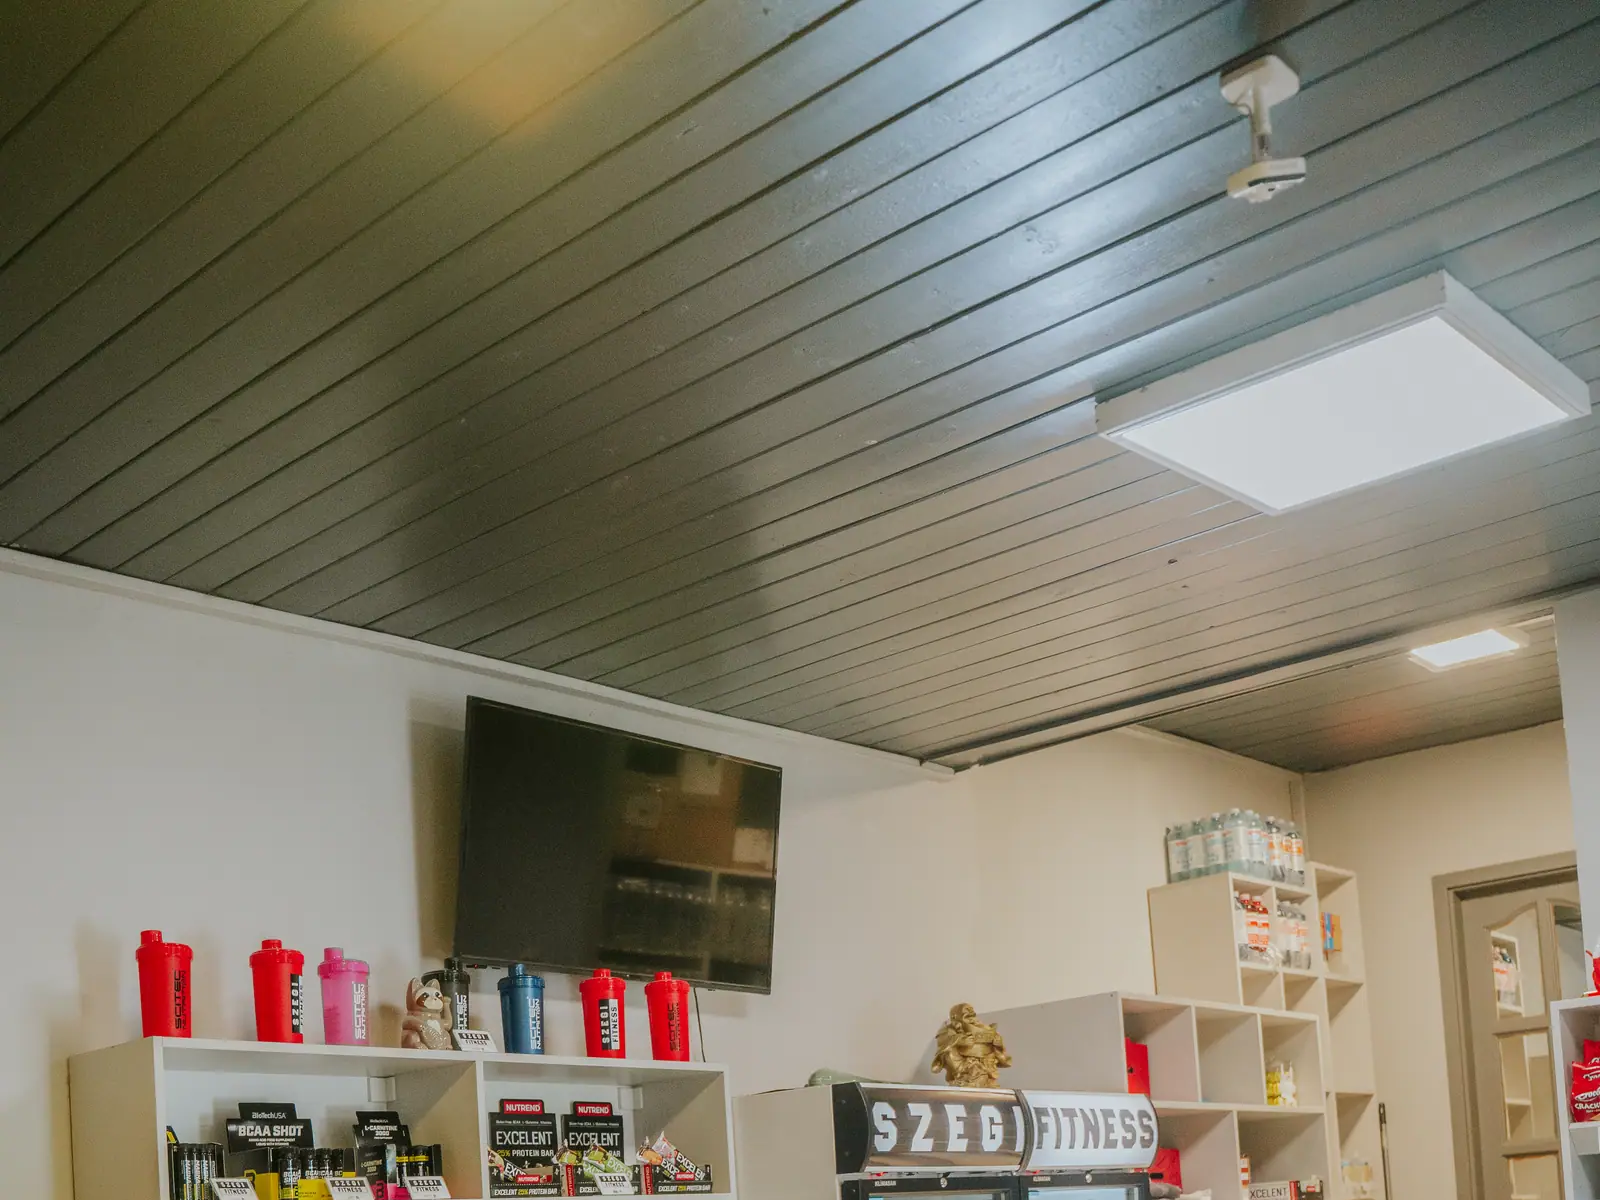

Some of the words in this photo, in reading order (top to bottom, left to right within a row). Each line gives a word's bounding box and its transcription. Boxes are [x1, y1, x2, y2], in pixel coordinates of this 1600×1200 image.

[173, 970, 182, 1029] SCITEC
[291, 982, 299, 1026] SZEGI
[353, 983, 362, 1040] SCITEC
[528, 998, 536, 1050] SCITEC
[600, 1005, 610, 1044] SZEGI
[611, 1006, 619, 1043] FITNESS
[667, 1002, 676, 1051] SCITEC
[505, 1103, 541, 1112] NUTREND
[578, 1106, 609, 1114] NUTREND
[238, 1126, 271, 1137] BCAA
[272, 1126, 304, 1137] SHOT
[496, 1131, 553, 1145] EXCELENT
[568, 1132, 620, 1147] EXCELENT
[872, 1102, 1025, 1152] SZEGI
[1033, 1106, 1154, 1150] FITNESS
[512, 1149, 540, 1157] PROTEIN
[540, 1149, 554, 1157] BAR
[1250, 1187, 1288, 1199] XCELENT
